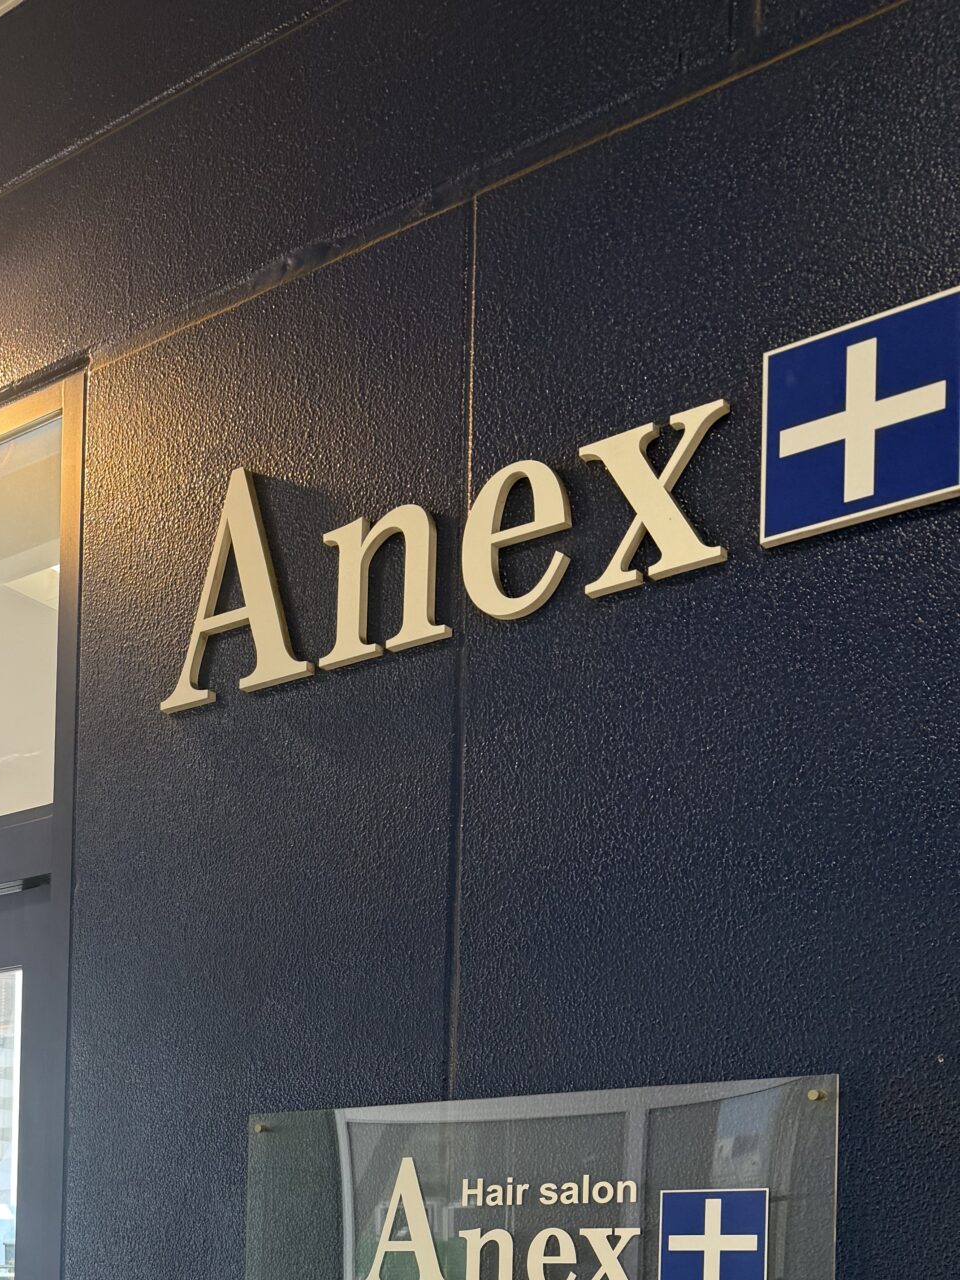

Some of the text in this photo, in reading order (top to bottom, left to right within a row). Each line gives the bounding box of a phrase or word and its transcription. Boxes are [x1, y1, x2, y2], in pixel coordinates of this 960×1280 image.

[160, 398, 730, 714] Anex
[460, 1175, 637, 1207] Hair salon
